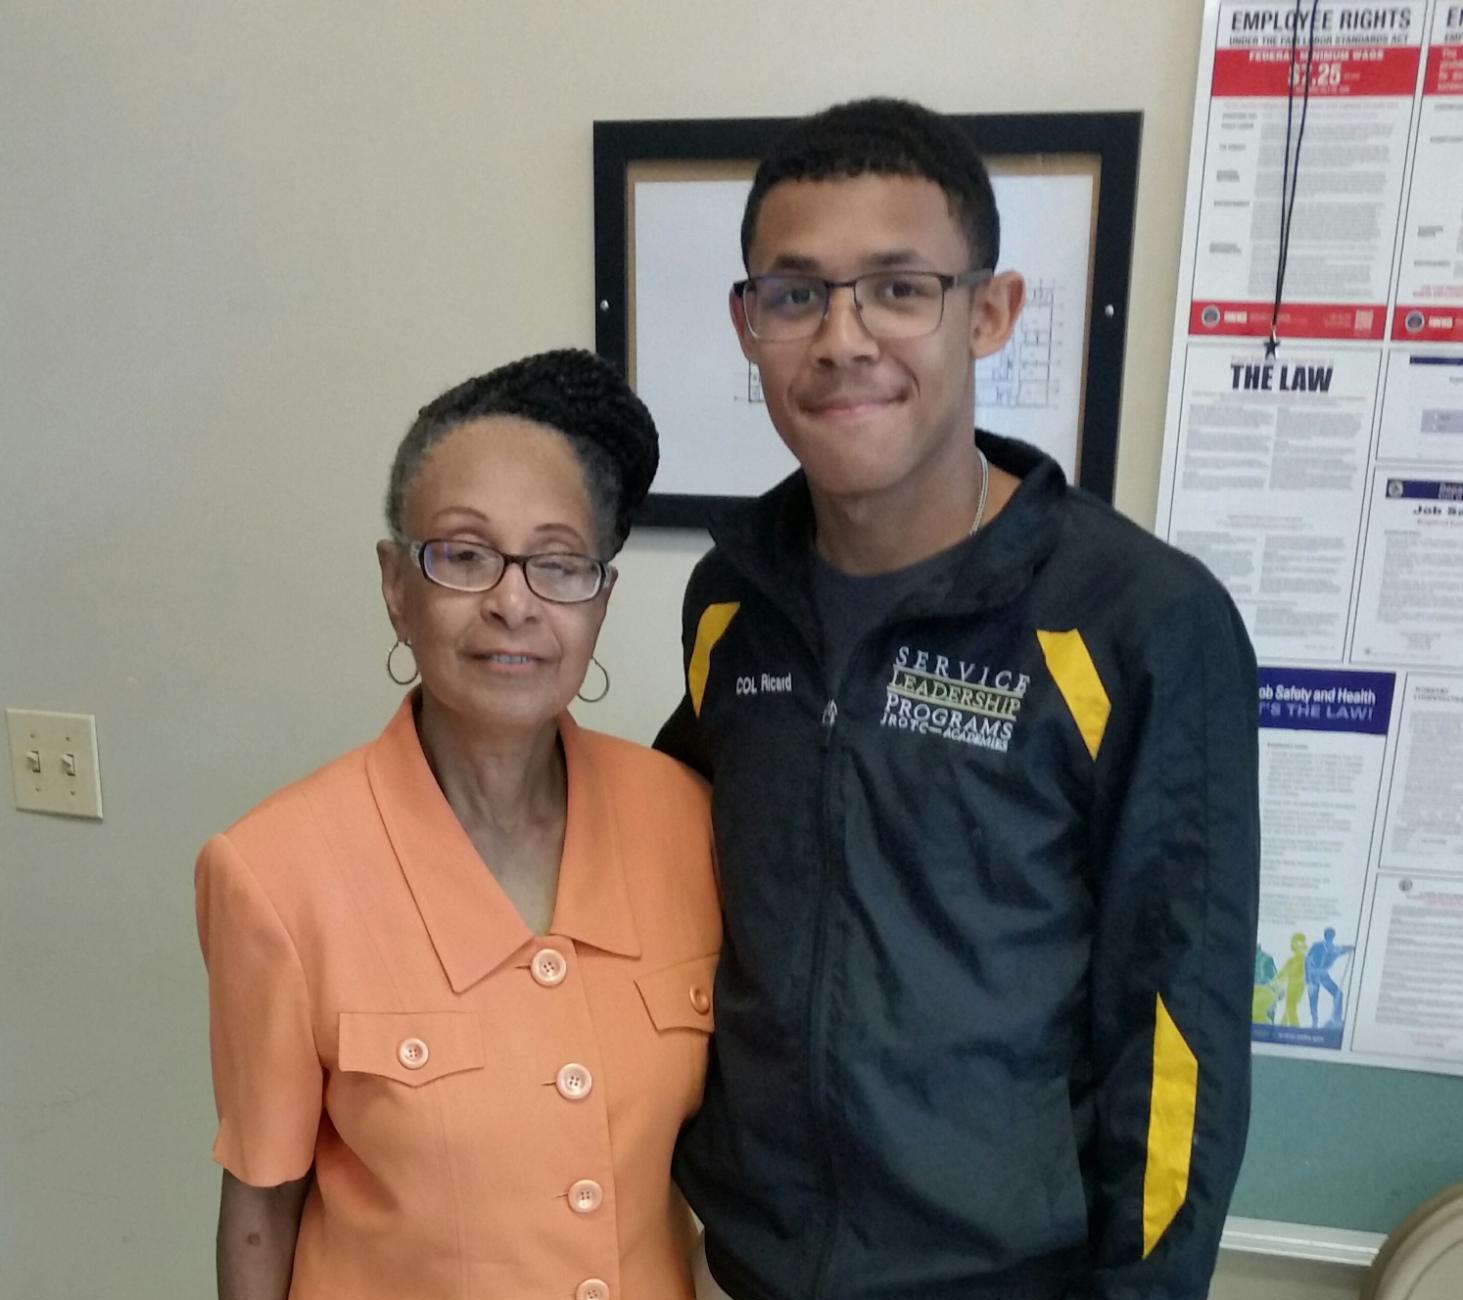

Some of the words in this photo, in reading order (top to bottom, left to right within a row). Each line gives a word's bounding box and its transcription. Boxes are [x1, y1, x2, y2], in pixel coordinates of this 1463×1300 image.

[1231, 9, 1334, 31] EMPLOYEE
[1339, 7, 1411, 31] RIGHTS
[1248, 49, 1294, 62] FEDERA
[1352, 49, 1384, 61] WAGE
[1231, 363, 1274, 390] THE
[1279, 365, 1333, 392] LAW
[1413, 504, 1442, 515] Job
[896, 646, 1030, 695] SERVICE
[736, 676, 757, 695] COL
[761, 672, 792, 692] Ricard
[890, 667, 1021, 716] LEADERSHIP
[1258, 684, 1273, 700] ob
[1275, 684, 1312, 704] Safety
[1313, 688, 1336, 703] and
[1338, 688, 1376, 705] Health
[884, 692, 1013, 741] PROGRAMS
[1287, 702, 1320, 718] THE
